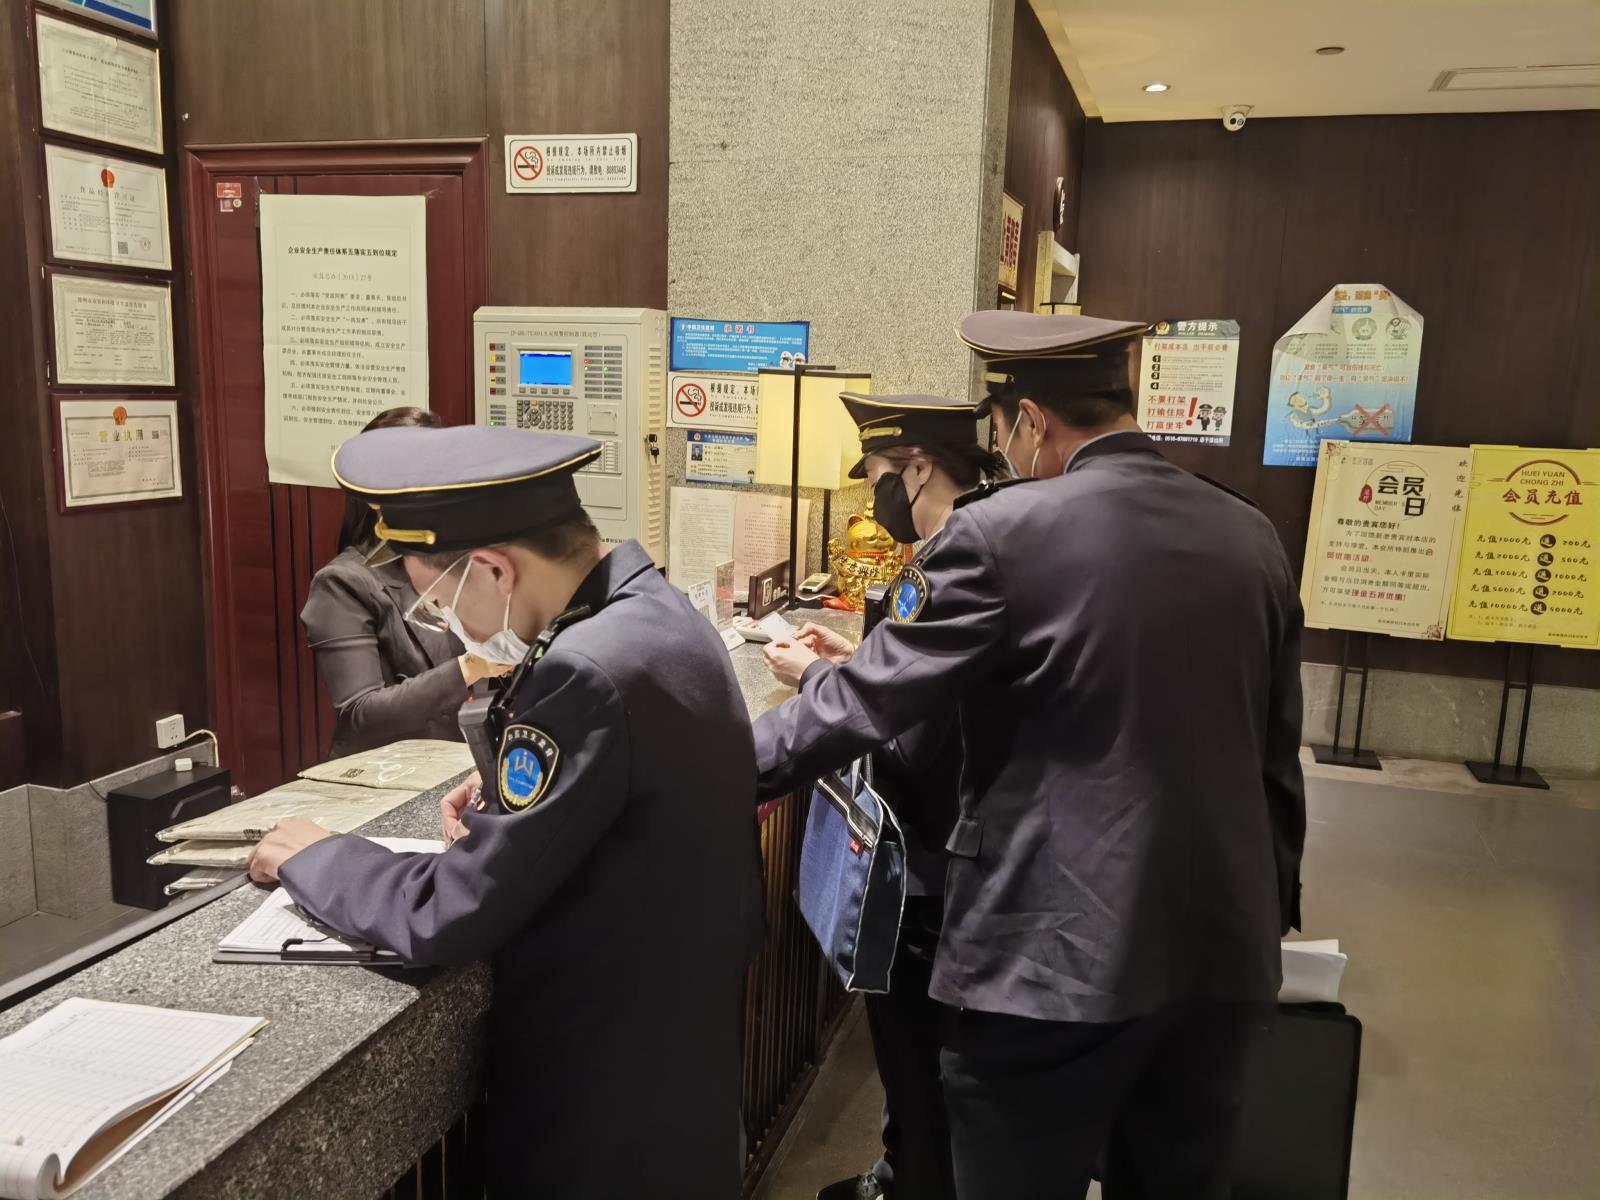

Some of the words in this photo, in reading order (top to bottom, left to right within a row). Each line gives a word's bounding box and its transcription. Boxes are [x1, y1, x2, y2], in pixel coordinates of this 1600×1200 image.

[1177, 321, 1218, 332] 警方提示
[1148, 395, 1186, 404] 不要打架
[1147, 408, 1185, 417] 打输住院
[1377, 475, 1426, 496] 会员
[1502, 488, 1583, 506] 会员充值
[1476, 534, 1531, 545] 充值1000元
[1563, 540, 1591, 548] 200元
[1561, 557, 1589, 565] 500元
